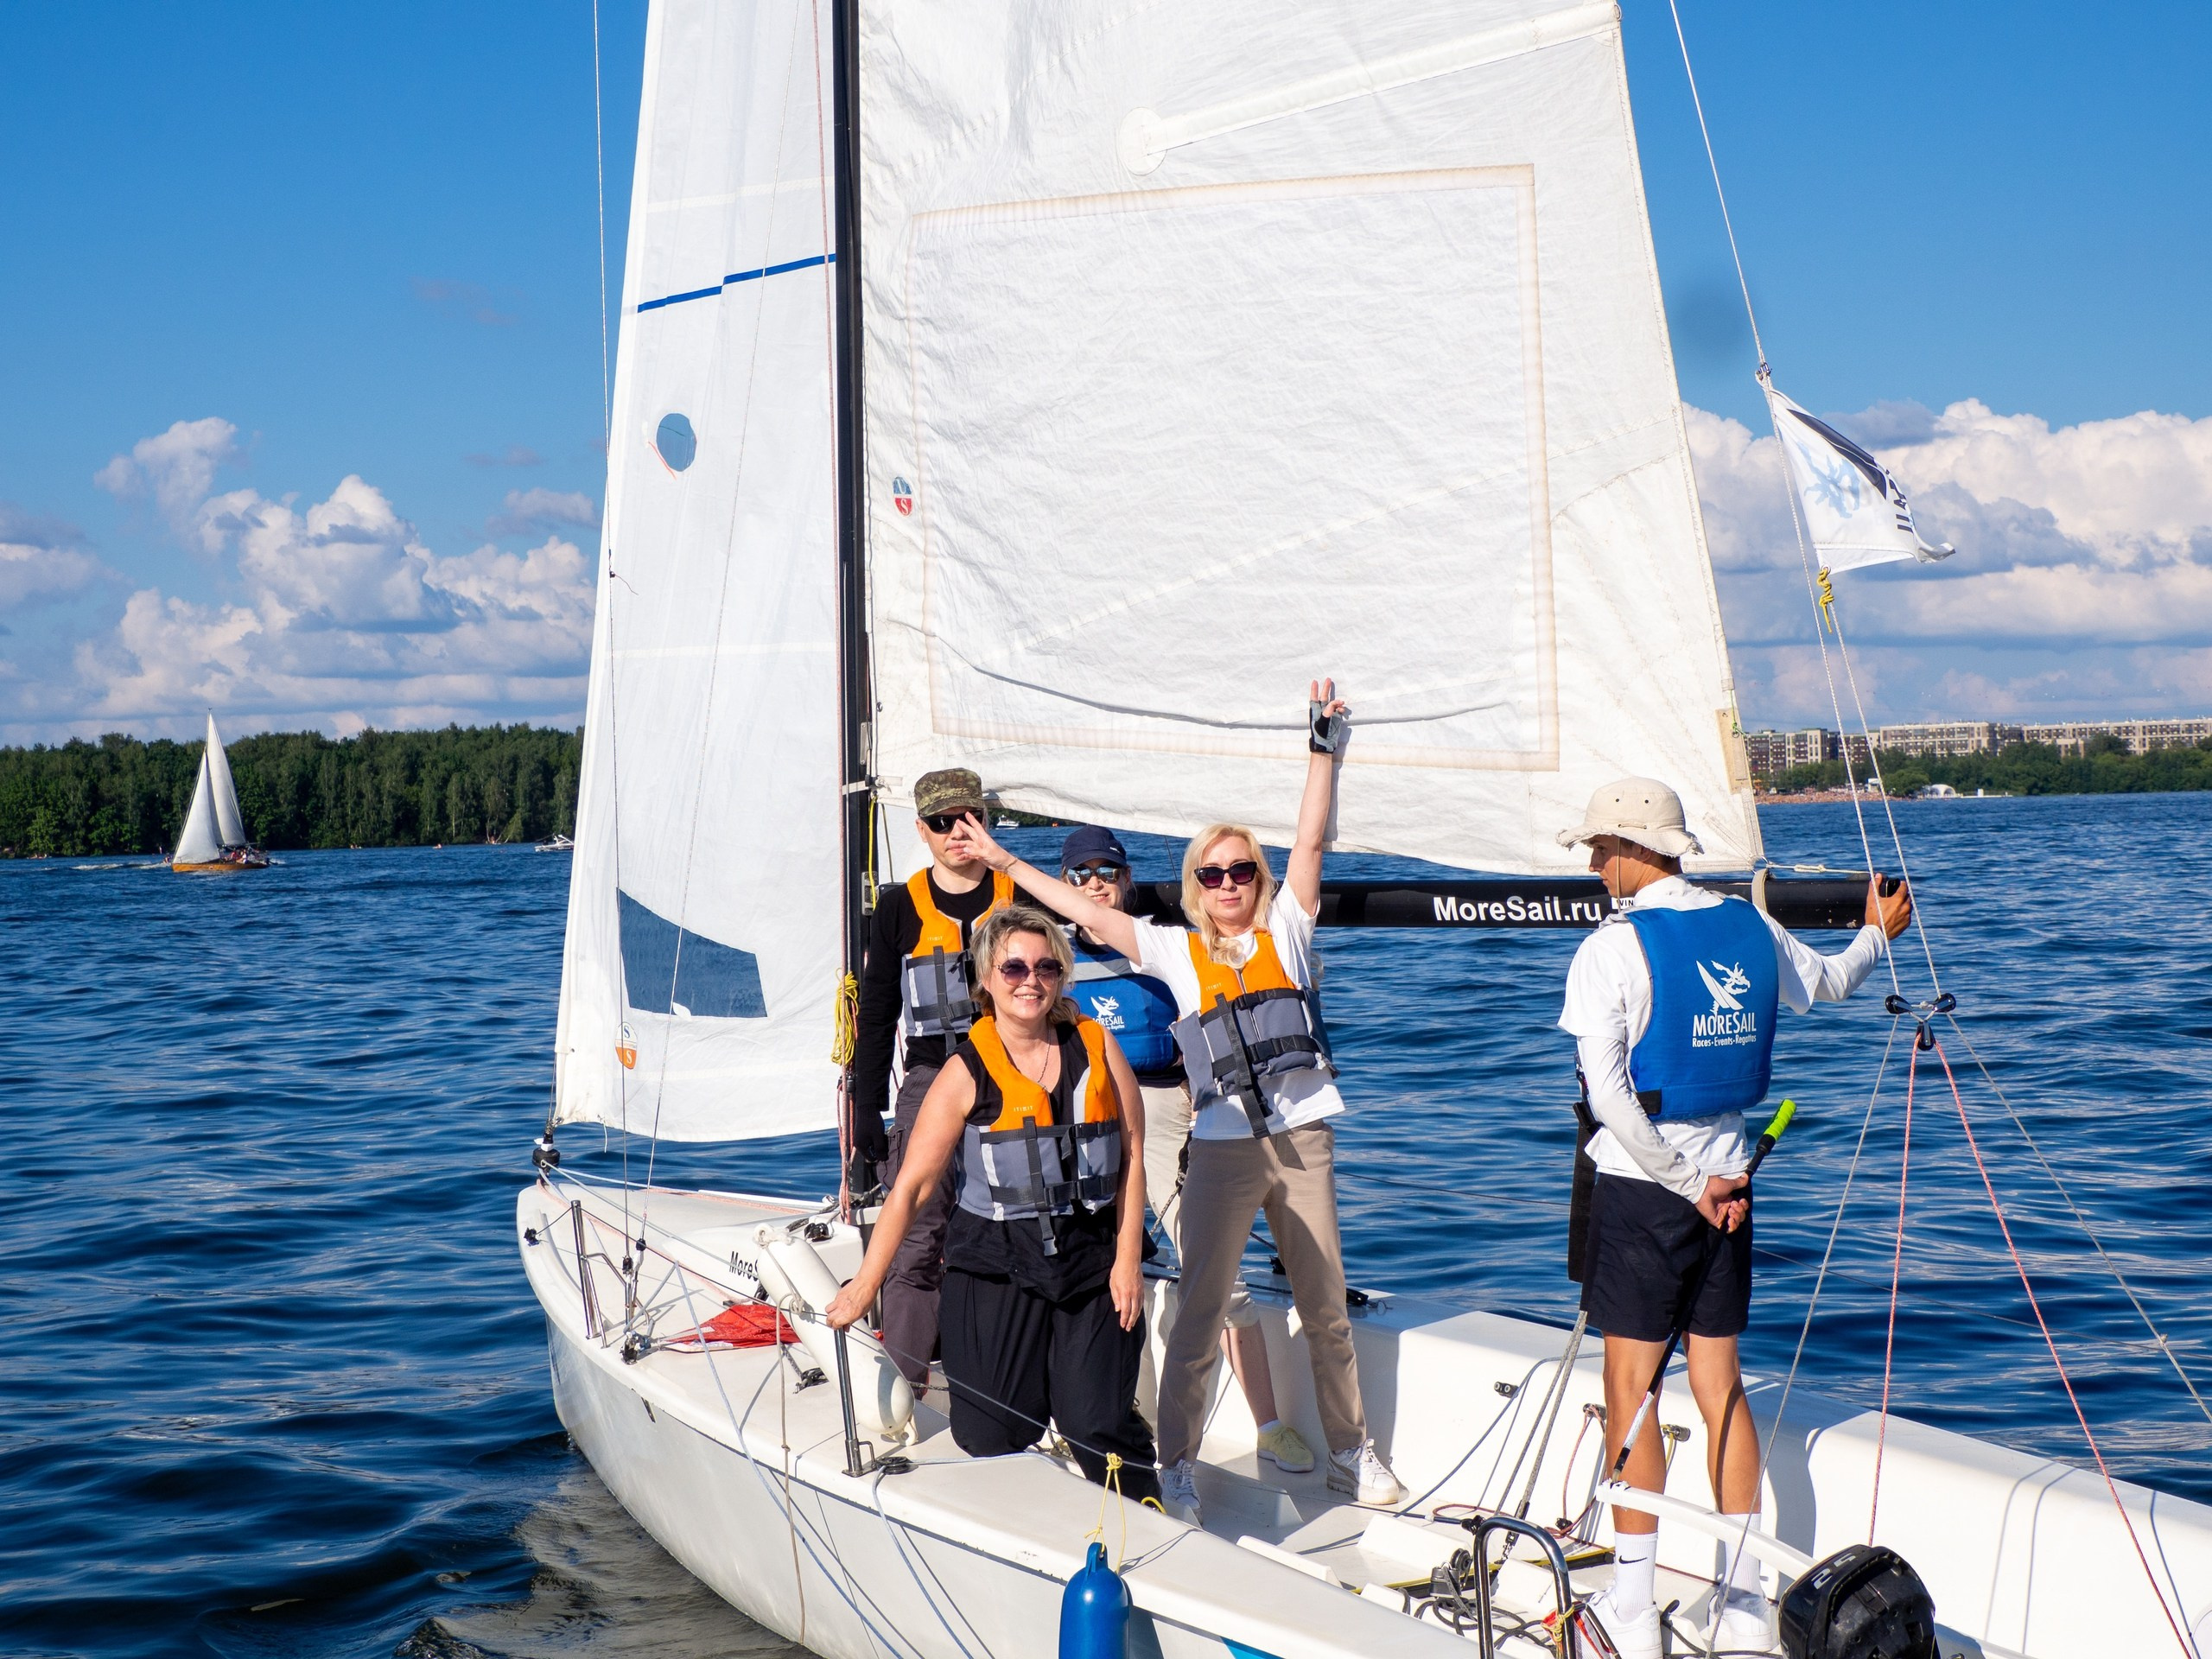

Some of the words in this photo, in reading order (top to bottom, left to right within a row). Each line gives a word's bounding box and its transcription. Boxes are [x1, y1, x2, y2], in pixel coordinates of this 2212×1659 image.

[1433, 895, 1602, 921] MoreSail.ru
[1092, 1015, 1124, 1027] ORESAIL
[1811, 1553, 1856, 1590] 25
